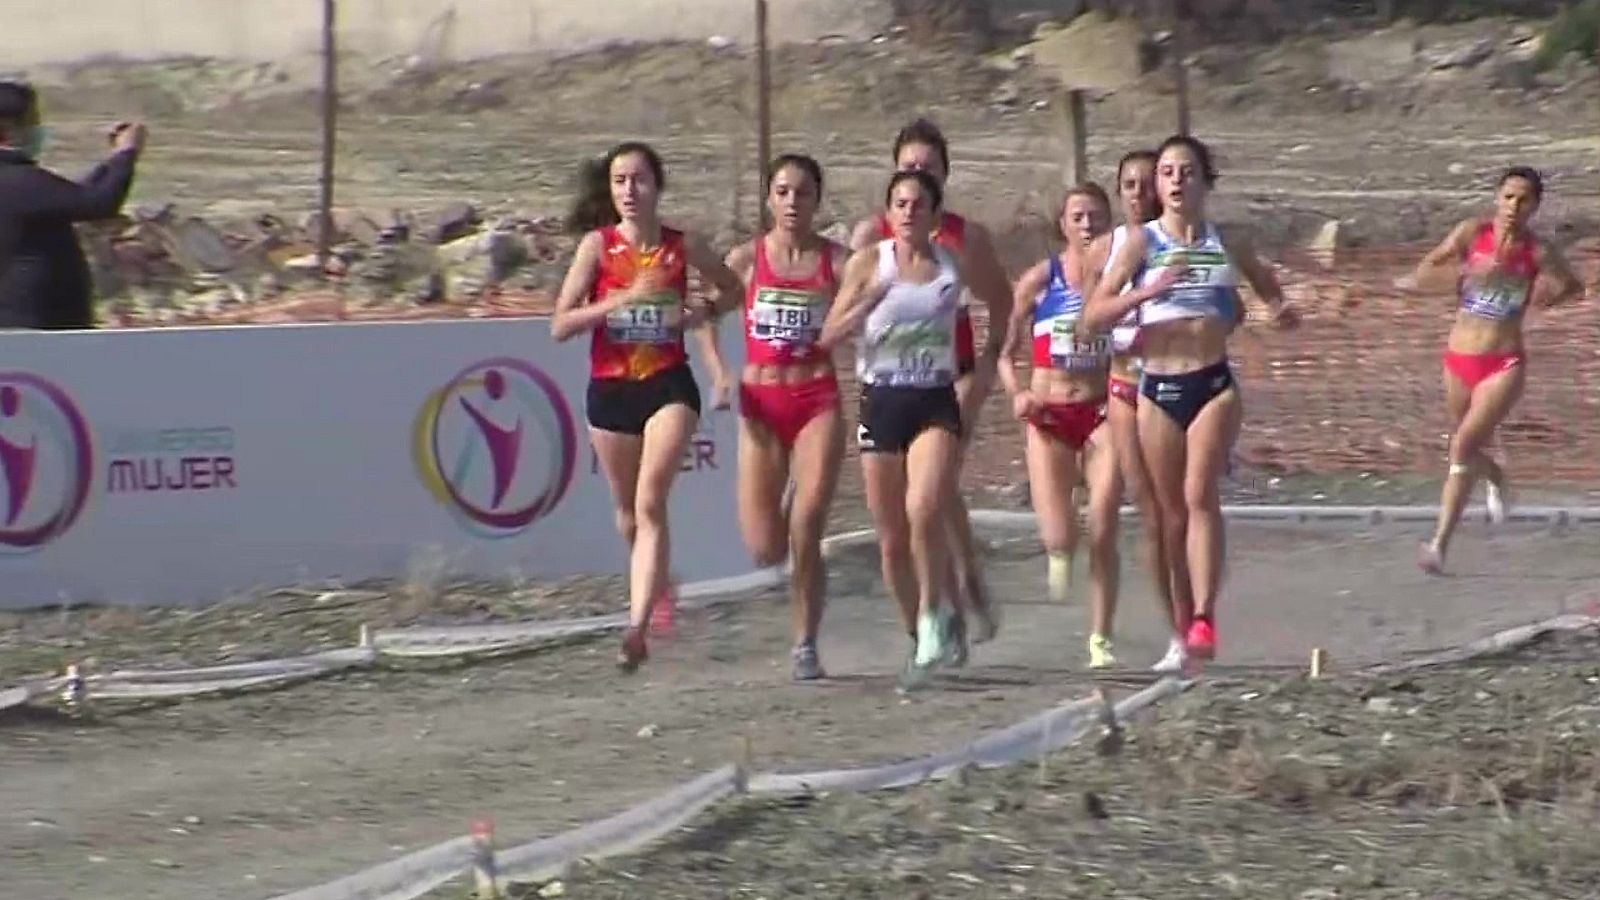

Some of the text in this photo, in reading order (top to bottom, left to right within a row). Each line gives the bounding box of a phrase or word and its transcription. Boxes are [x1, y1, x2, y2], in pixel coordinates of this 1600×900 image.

[629, 308, 664, 326] 141
[776, 308, 810, 326] 180
[107, 456, 237, 493] MUJER
